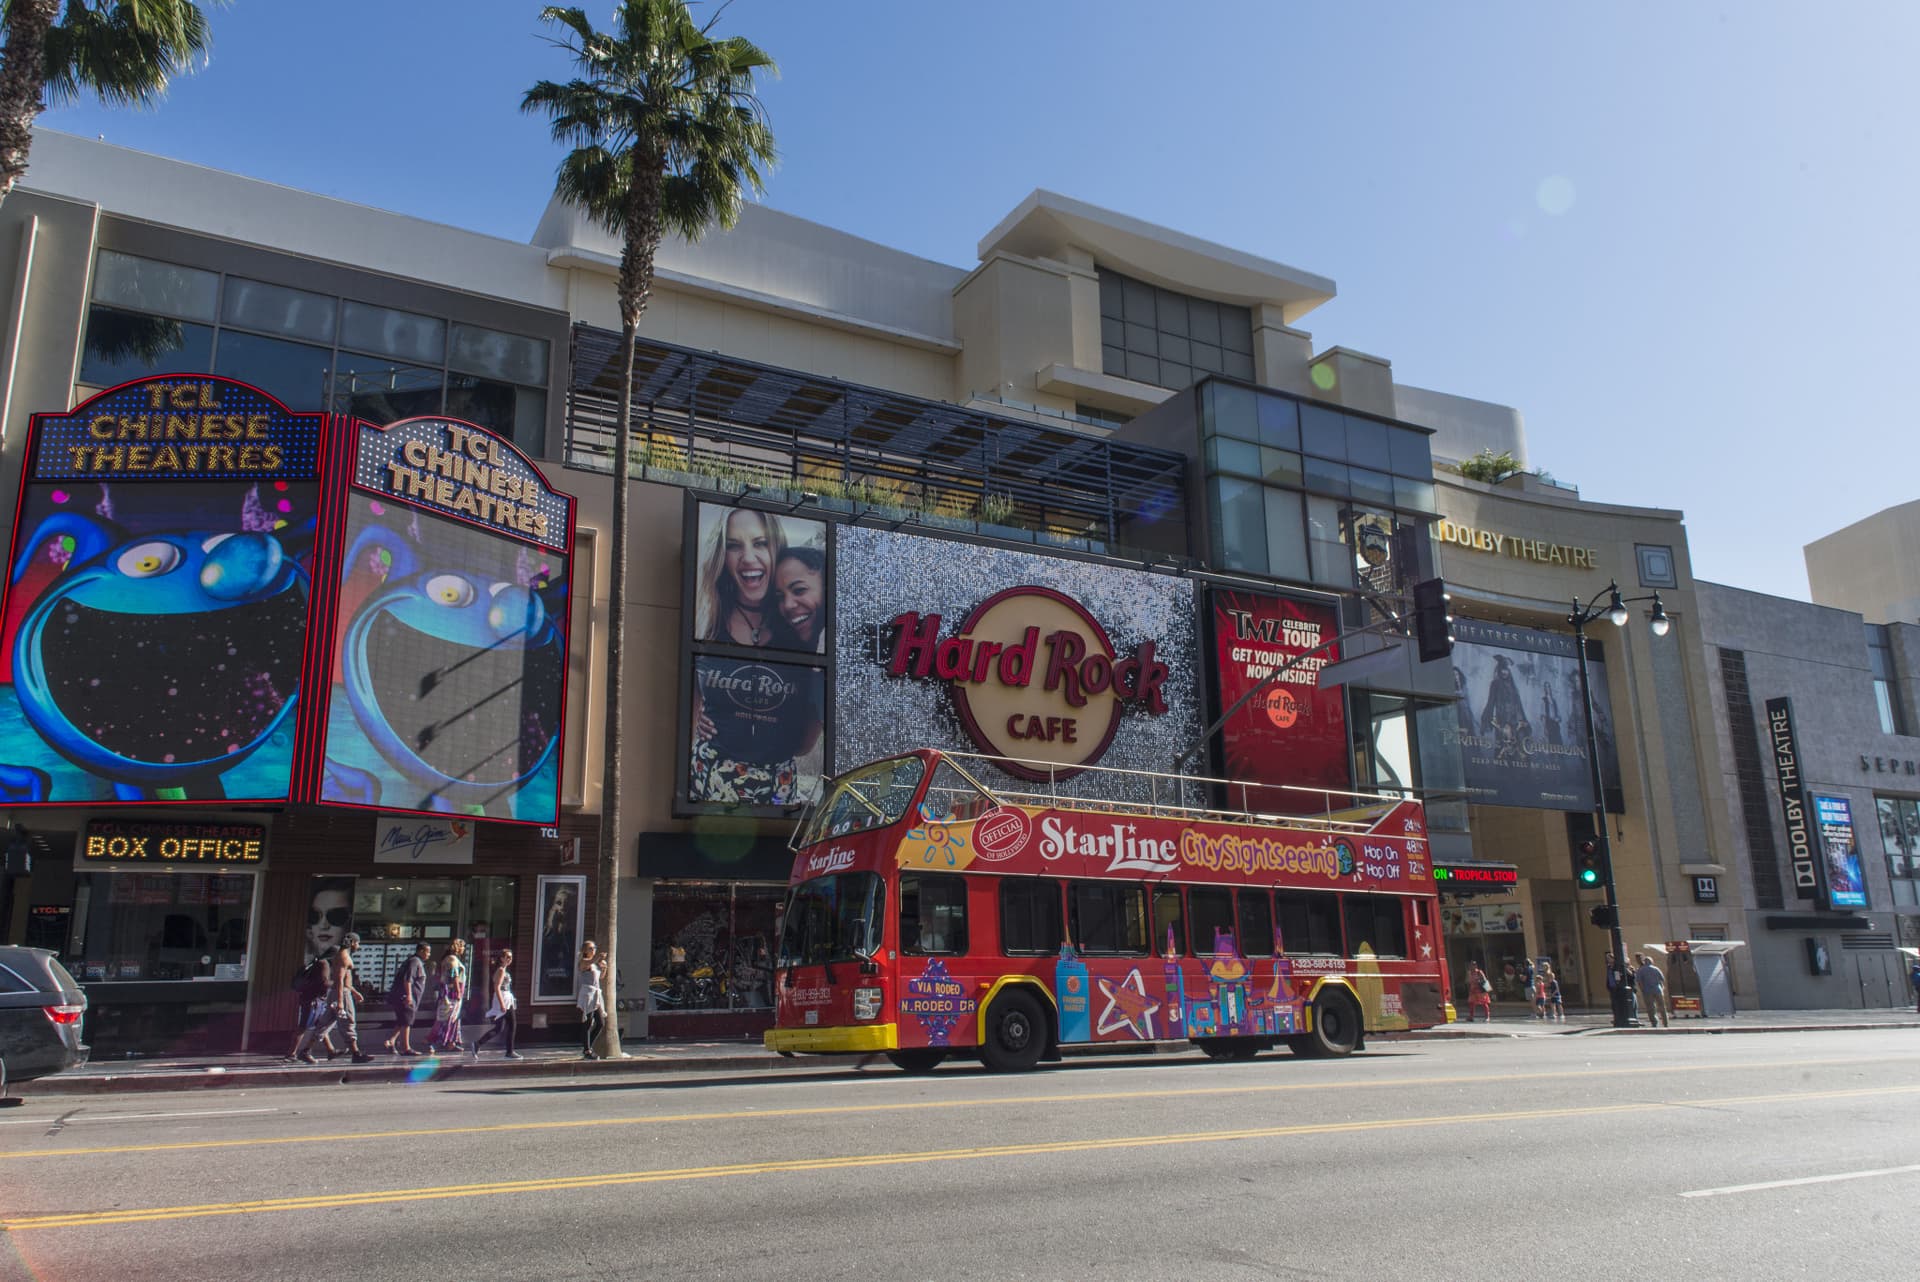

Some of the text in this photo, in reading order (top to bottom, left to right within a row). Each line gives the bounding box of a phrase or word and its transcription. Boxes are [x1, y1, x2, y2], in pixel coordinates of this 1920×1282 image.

[146, 383, 222, 409] TCL
[89, 414, 270, 439] CHINESE
[69, 444, 284, 471] THEATRES
[448, 423, 506, 468] TCL
[403, 440, 540, 508] CHINESE
[388, 460, 549, 538] THEATRES
[1444, 521, 1601, 569] DOLBY THEATRE
[1227, 608, 1321, 645] TMZ CELEBRITY
[1283, 629, 1321, 650] TOUR
[887, 610, 1170, 715] Hard Rock
[1232, 647, 1253, 663] GET
[1255, 650, 1284, 668] YOUR
[1277, 668, 1317, 686] INSIDE!
[1007, 713, 1078, 744] CAFE
[1860, 754, 1920, 777] SEPH
[1771, 708, 1810, 864] DOLBY THEATRE
[540, 828, 559, 838] TCL
[981, 819, 1021, 846] OFFICIAL
[1039, 816, 1181, 873] StarLine
[86, 836, 261, 860] BOX OFFICE
[1180, 828, 1341, 880] CitySightseeing
[1364, 845, 1399, 861] Hop On
[1366, 863, 1401, 879] Hop Off
[1453, 869, 1492, 881] TROPICAL
[918, 982, 961, 995] VIA RODEO
[959, 1000, 975, 1012] DR
